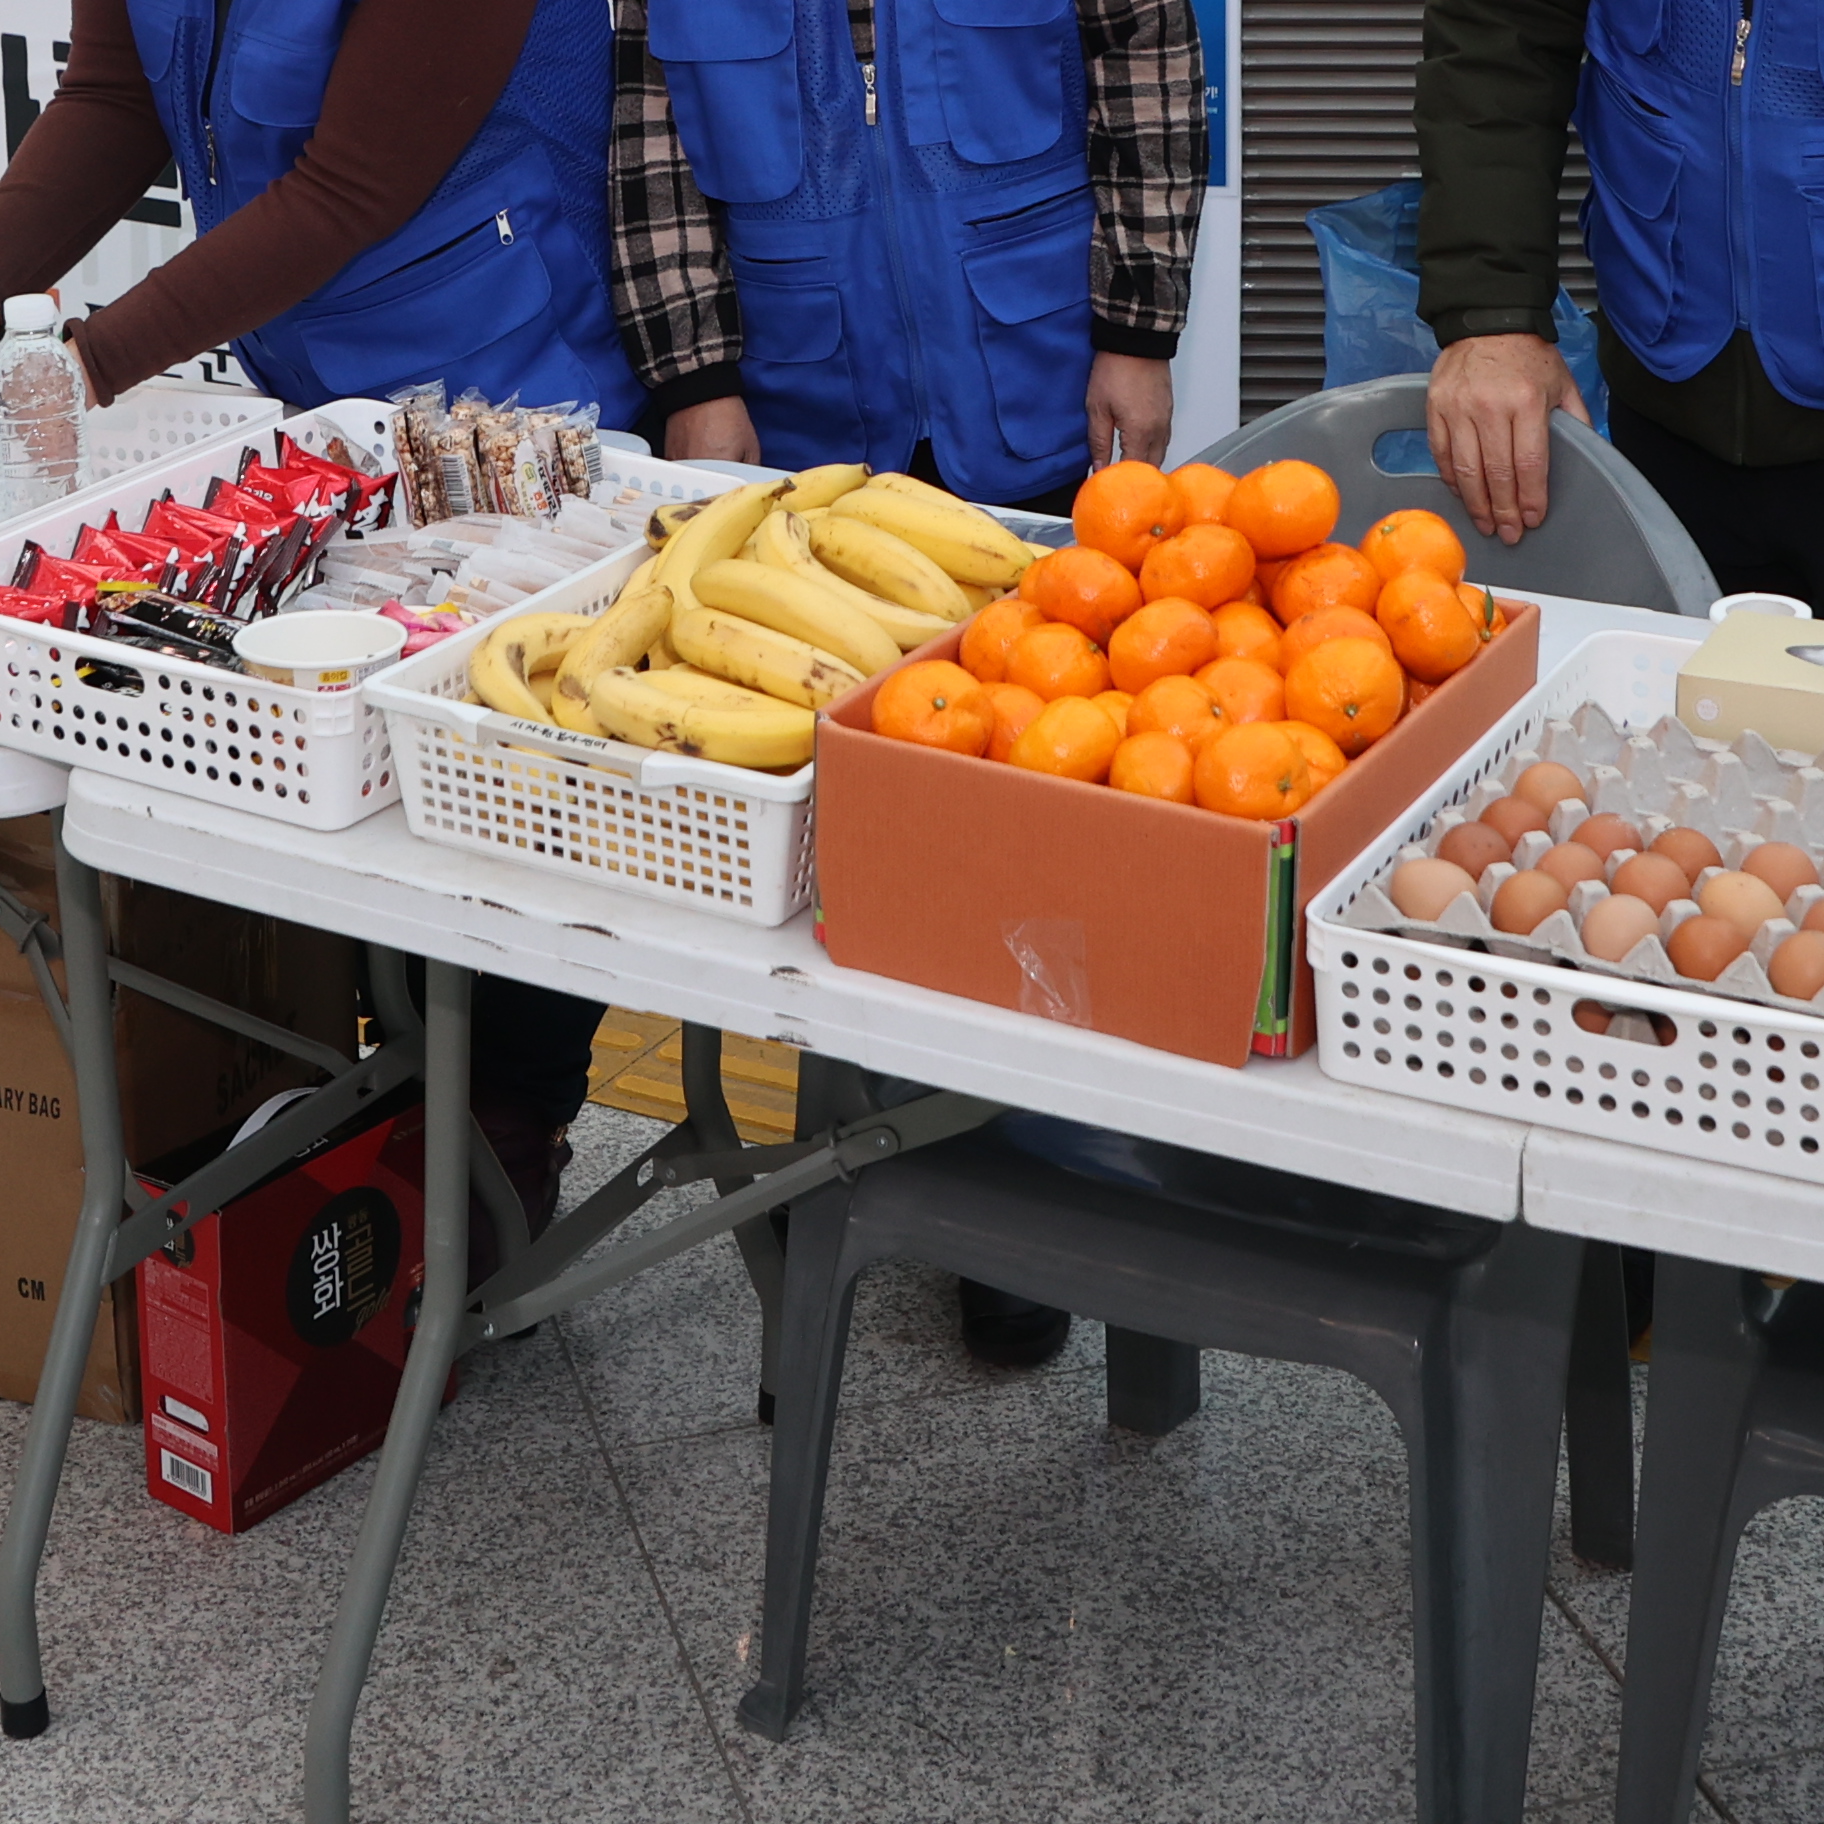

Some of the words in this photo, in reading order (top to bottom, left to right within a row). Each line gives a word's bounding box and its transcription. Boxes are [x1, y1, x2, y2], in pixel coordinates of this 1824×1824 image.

[28, 1091, 62, 1121] BAG
[310, 1221, 345, 1320] 쌍화
[18, 1274, 46, 1303] CM
